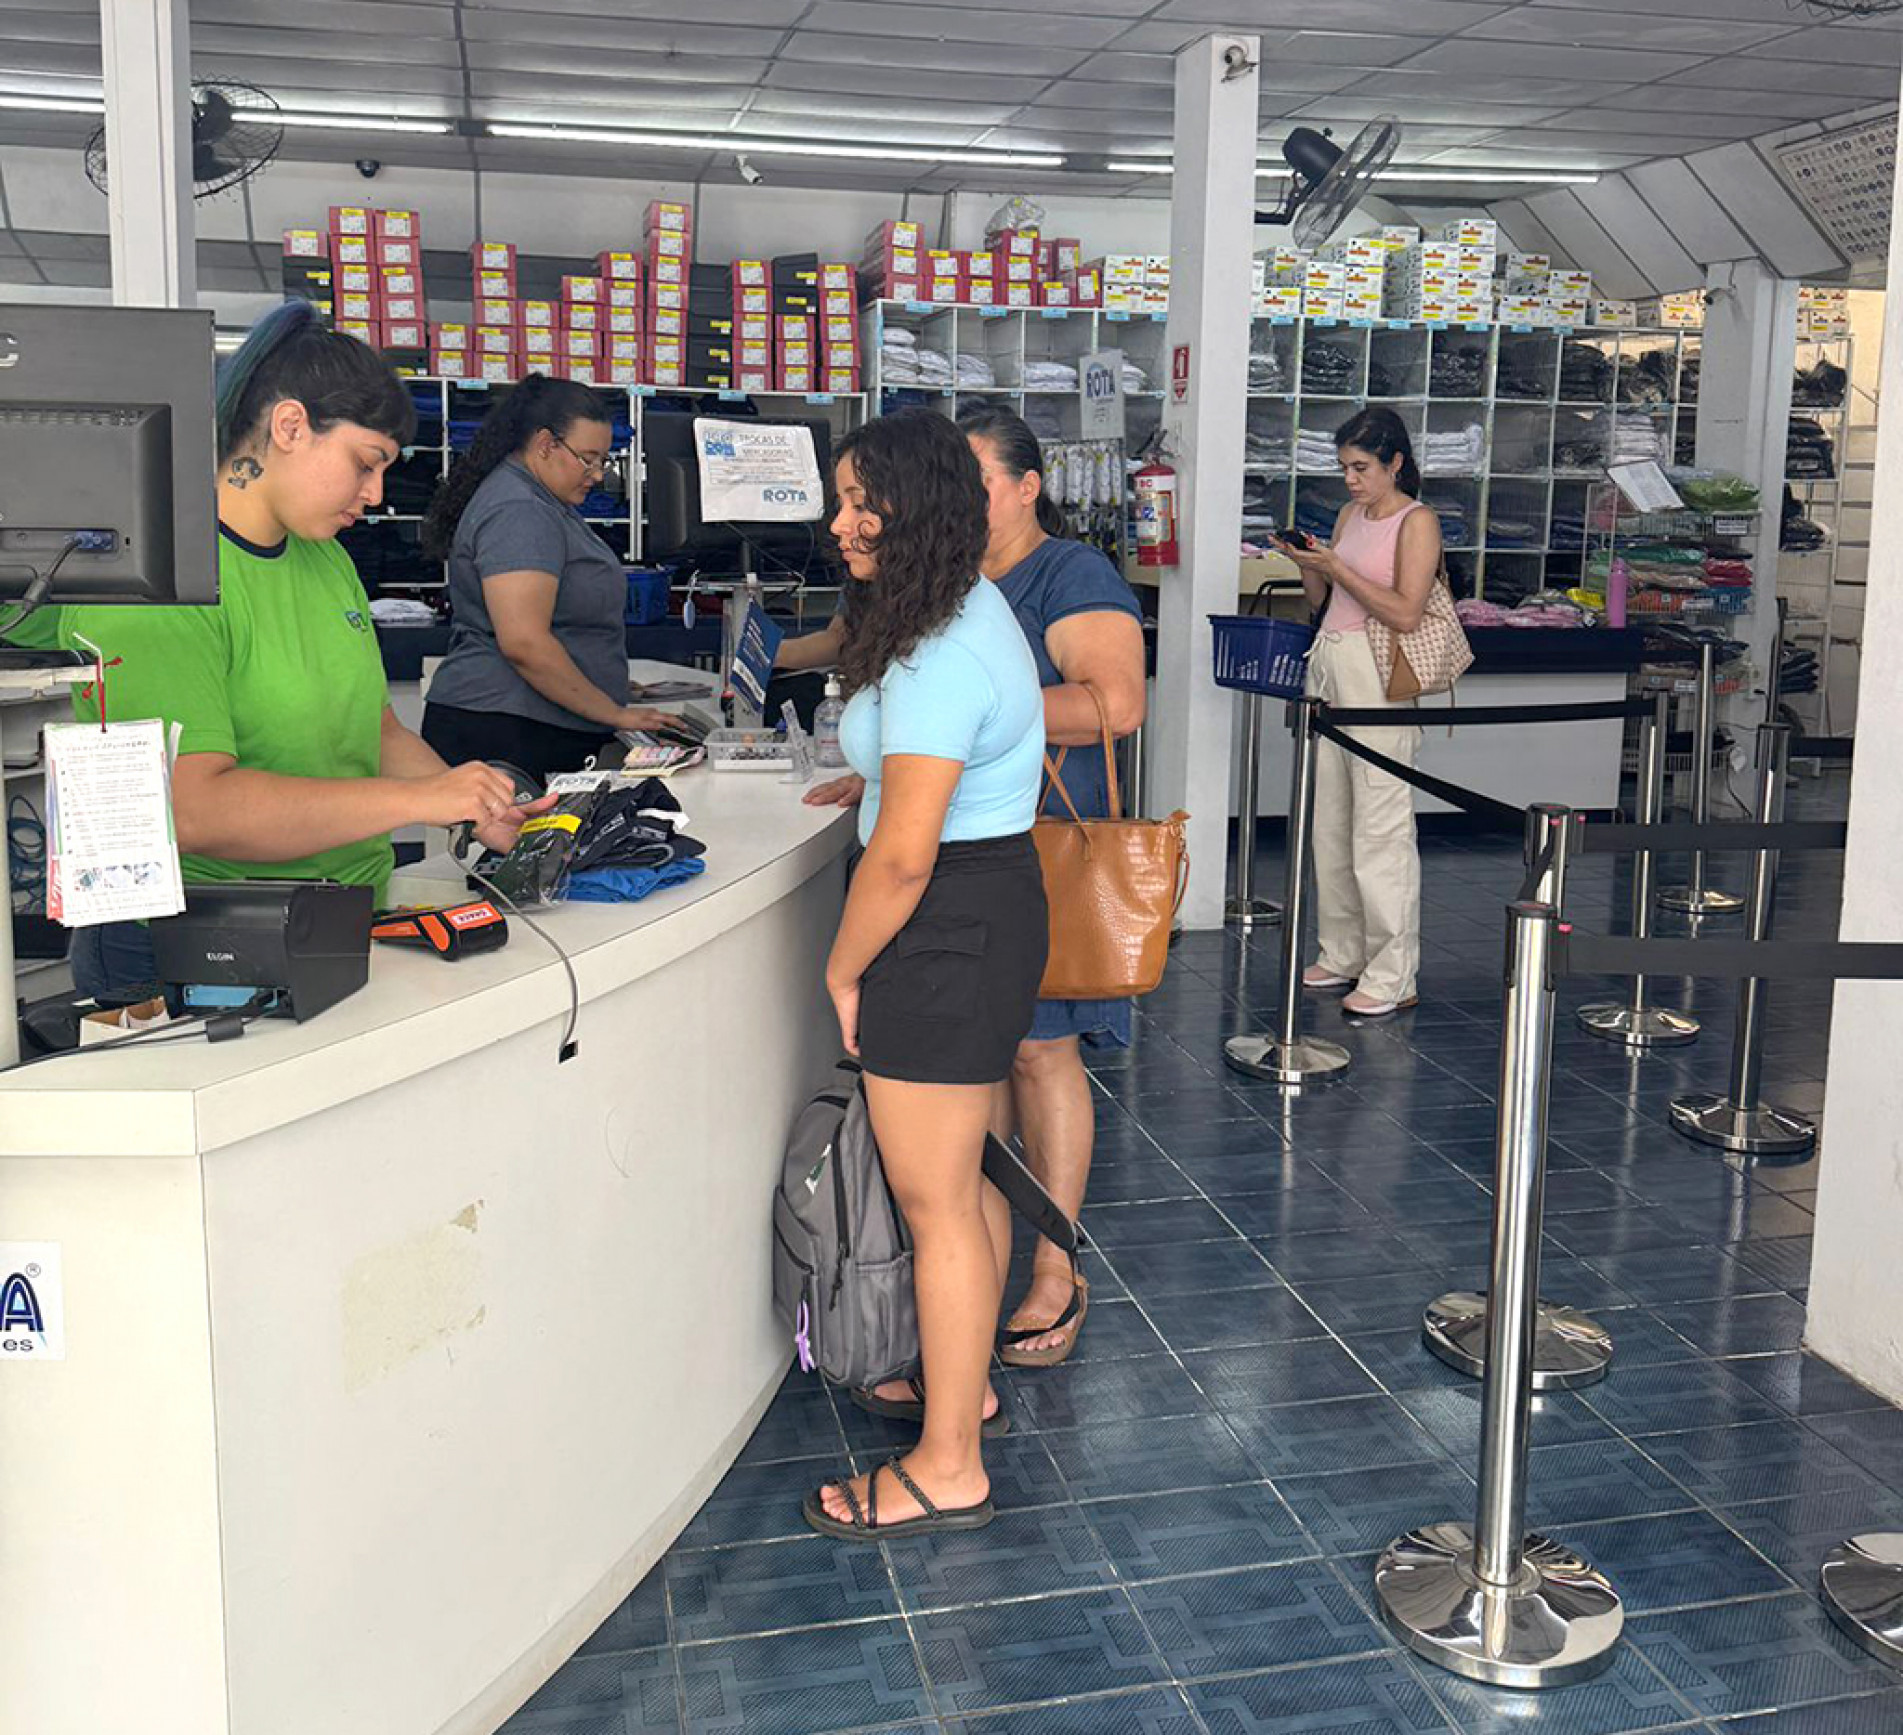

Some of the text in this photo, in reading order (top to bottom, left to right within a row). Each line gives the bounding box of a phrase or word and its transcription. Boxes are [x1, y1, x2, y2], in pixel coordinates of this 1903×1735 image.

[763, 489, 808, 502] ROTA
[205, 952, 235, 961] ELGIN
[2, 1339, 34, 1353] es
